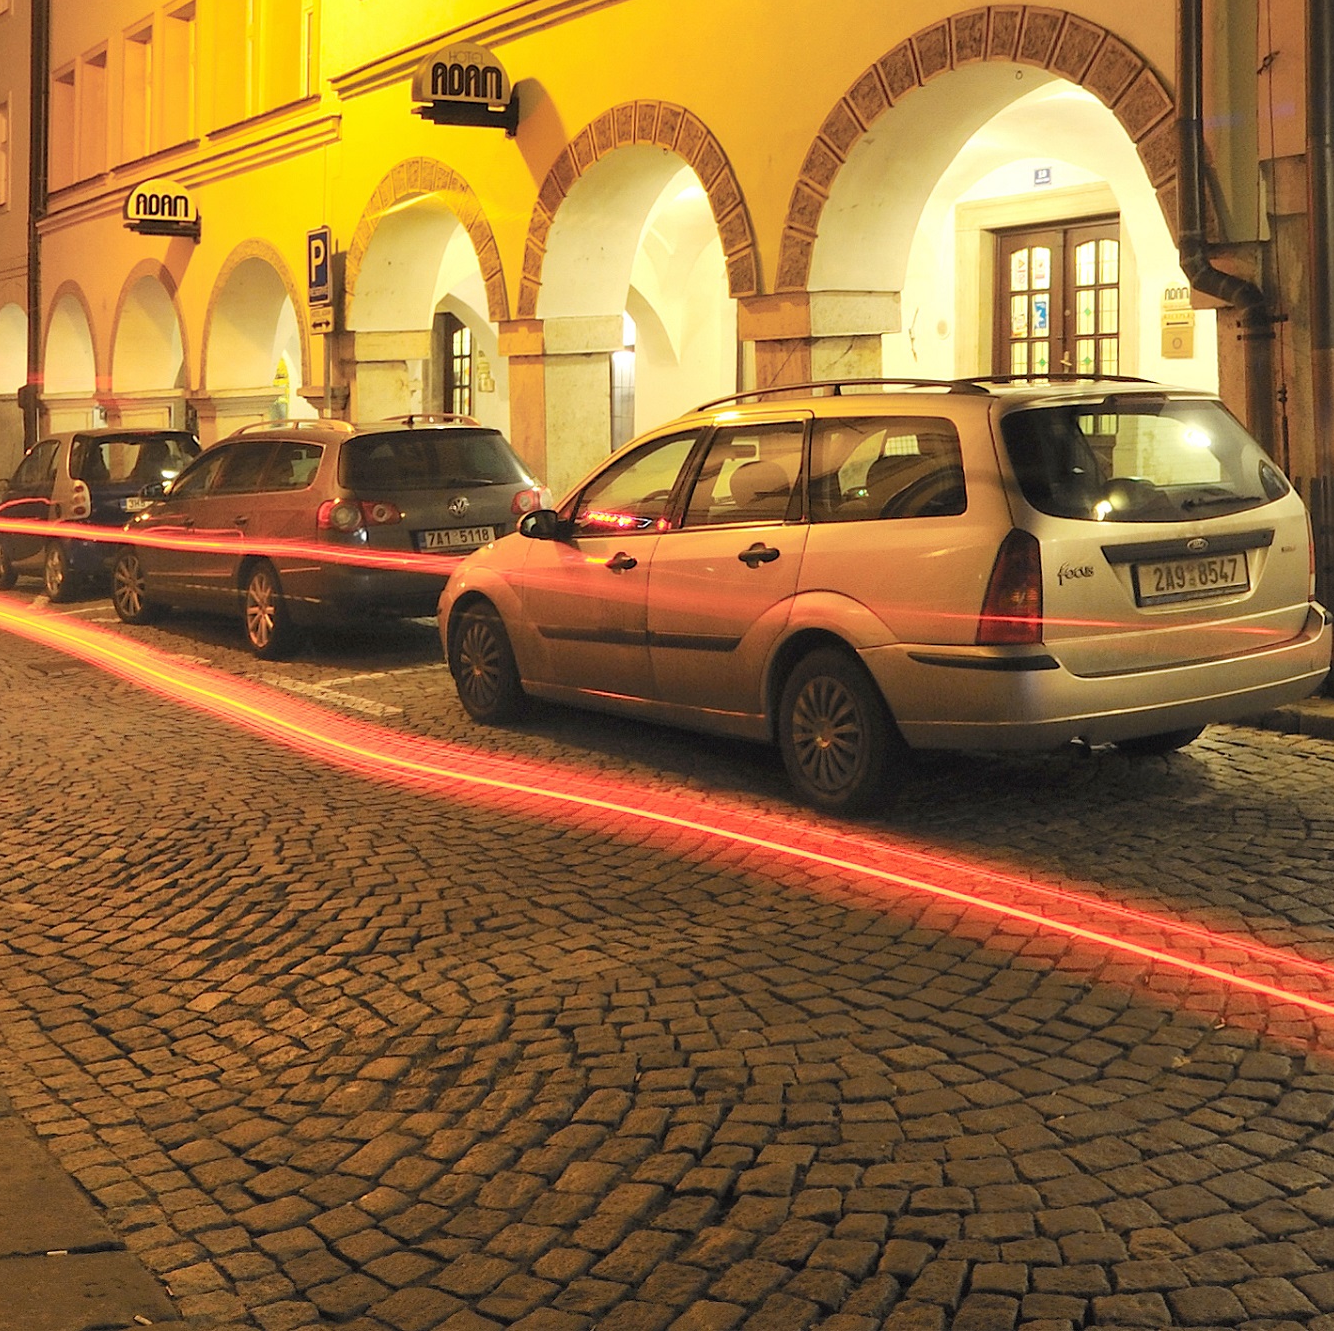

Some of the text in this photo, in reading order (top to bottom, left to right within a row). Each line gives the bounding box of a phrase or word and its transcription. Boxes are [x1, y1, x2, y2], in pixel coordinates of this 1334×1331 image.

[449, 51, 484, 64] HOTEL
[431, 62, 503, 100] ADAM
[136, 193, 188, 218] ADAM
[310, 238, 326, 283] P
[428, 528, 490, 547] 7A1 5118
[1153, 558, 1238, 592] 2A9 8547
